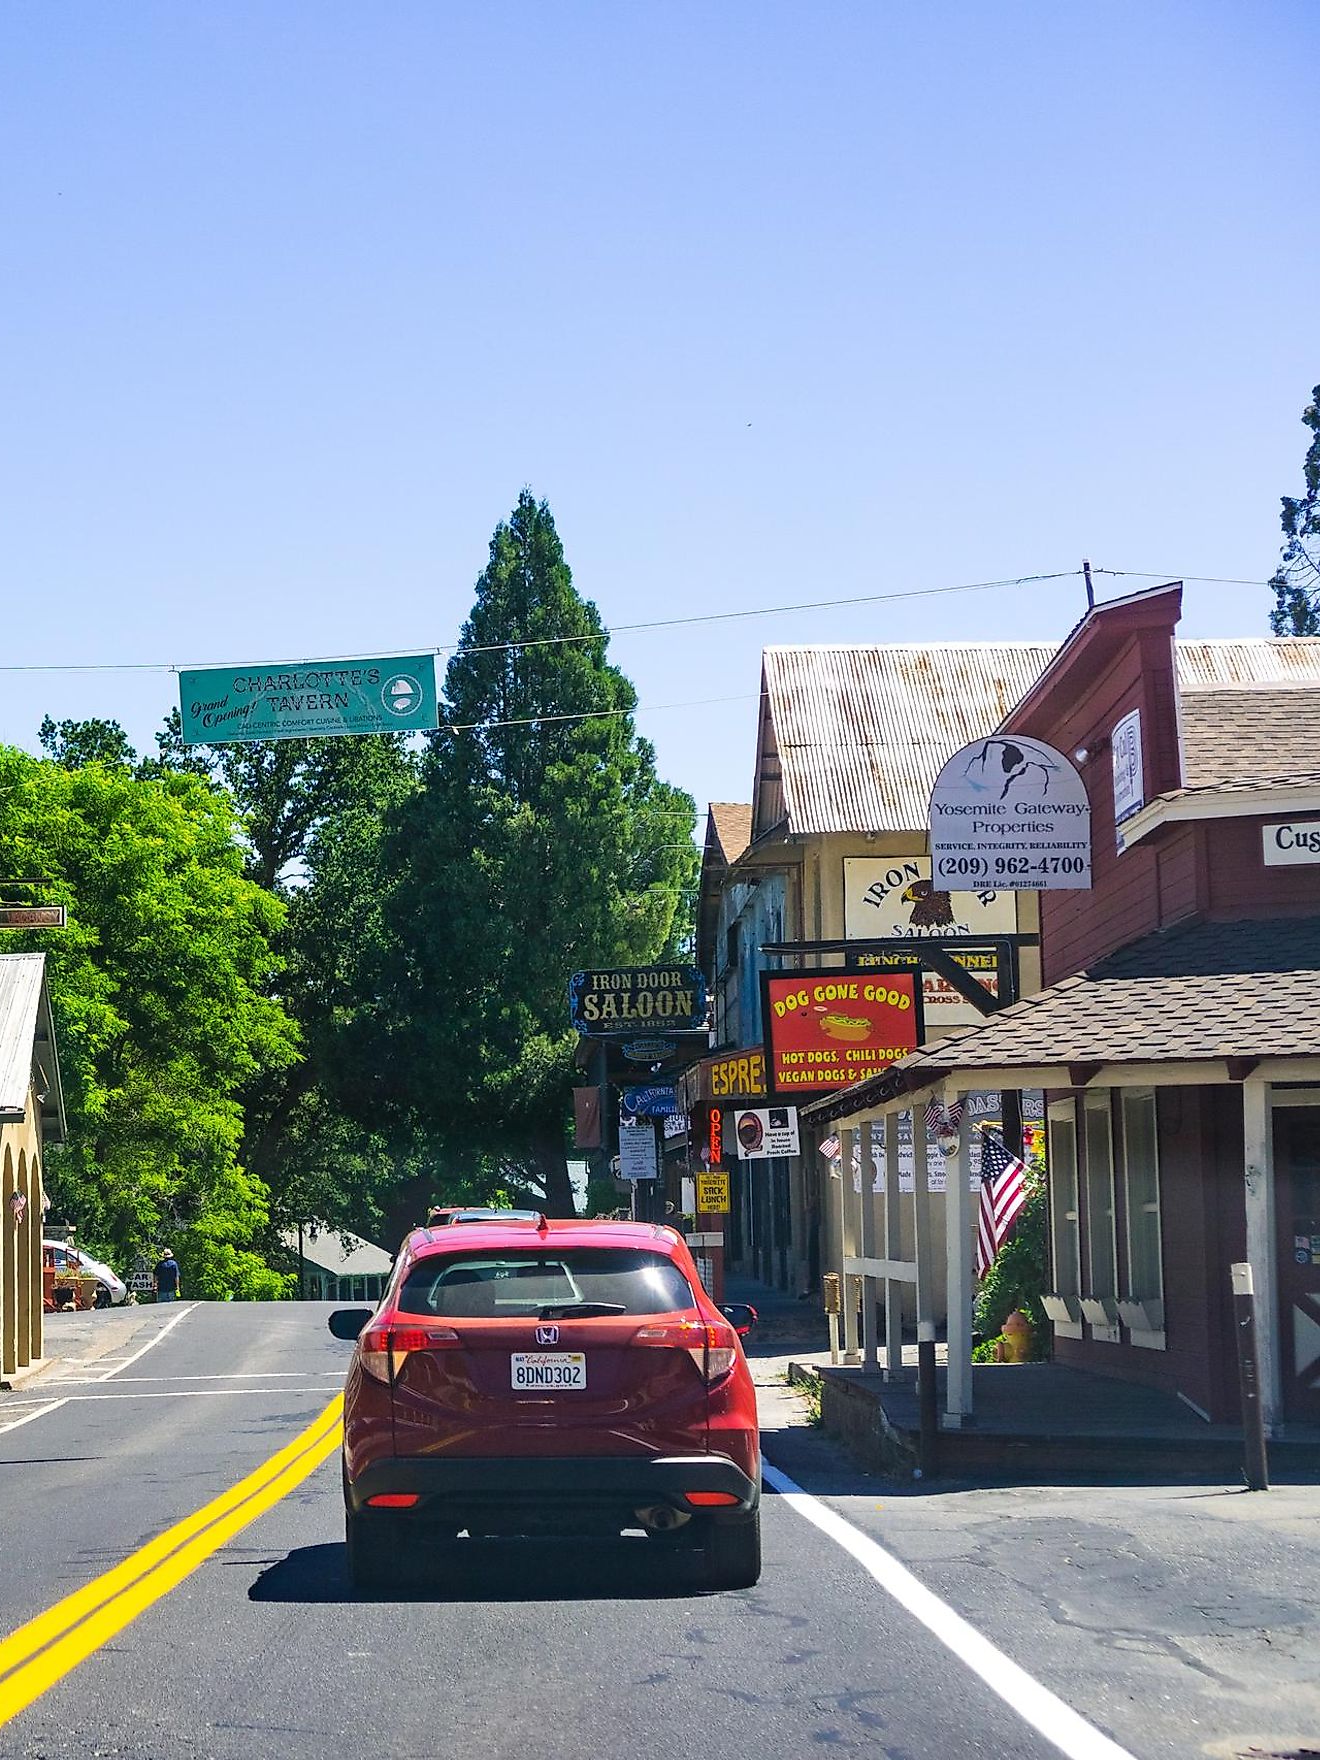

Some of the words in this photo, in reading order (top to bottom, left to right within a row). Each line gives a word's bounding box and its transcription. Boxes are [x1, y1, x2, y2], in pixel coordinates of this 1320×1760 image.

[233, 668, 380, 693] CHARLOTTE'S
[190, 694, 229, 719] Grand
[266, 692, 349, 712] TAVERN
[202, 701, 257, 728] Opening!
[282, 718, 314, 727] COMFORT
[935, 803, 1007, 816] Yosemite
[1014, 802, 1085, 816] Gateway
[973, 821, 1054, 835] Properties
[1275, 825, 1320, 853] Cus
[938, 858, 988, 877] (209)
[995, 857, 1084, 874] 962-4700
[863, 862, 921, 908] IRON
[891, 924, 971, 937] SALOON
[591, 974, 632, 990] IRON
[636, 971, 682, 988] DOOR
[584, 990, 693, 1020] SALOON
[773, 990, 809, 1018] DOG
[813, 984, 859, 1001] GONE
[864, 985, 911, 1010] GOOD
[782, 1052, 805, 1064] HOT
[807, 1050, 840, 1063] DOGS,
[845, 1050, 876, 1061] CHILI
[878, 1048, 908, 1060] DOGS
[779, 1071, 815, 1083] VEGAN
[817, 1069, 846, 1081] DOGS
[848, 1068, 857, 1080] &
[623, 1087, 674, 1112] CALIFORNIA
[710, 1109, 721, 1163] OPEN
[701, 1195, 727, 1203] LUNCH
[703, 1186, 724, 1195] SACK
[516, 1366, 581, 1384] 8DND302
